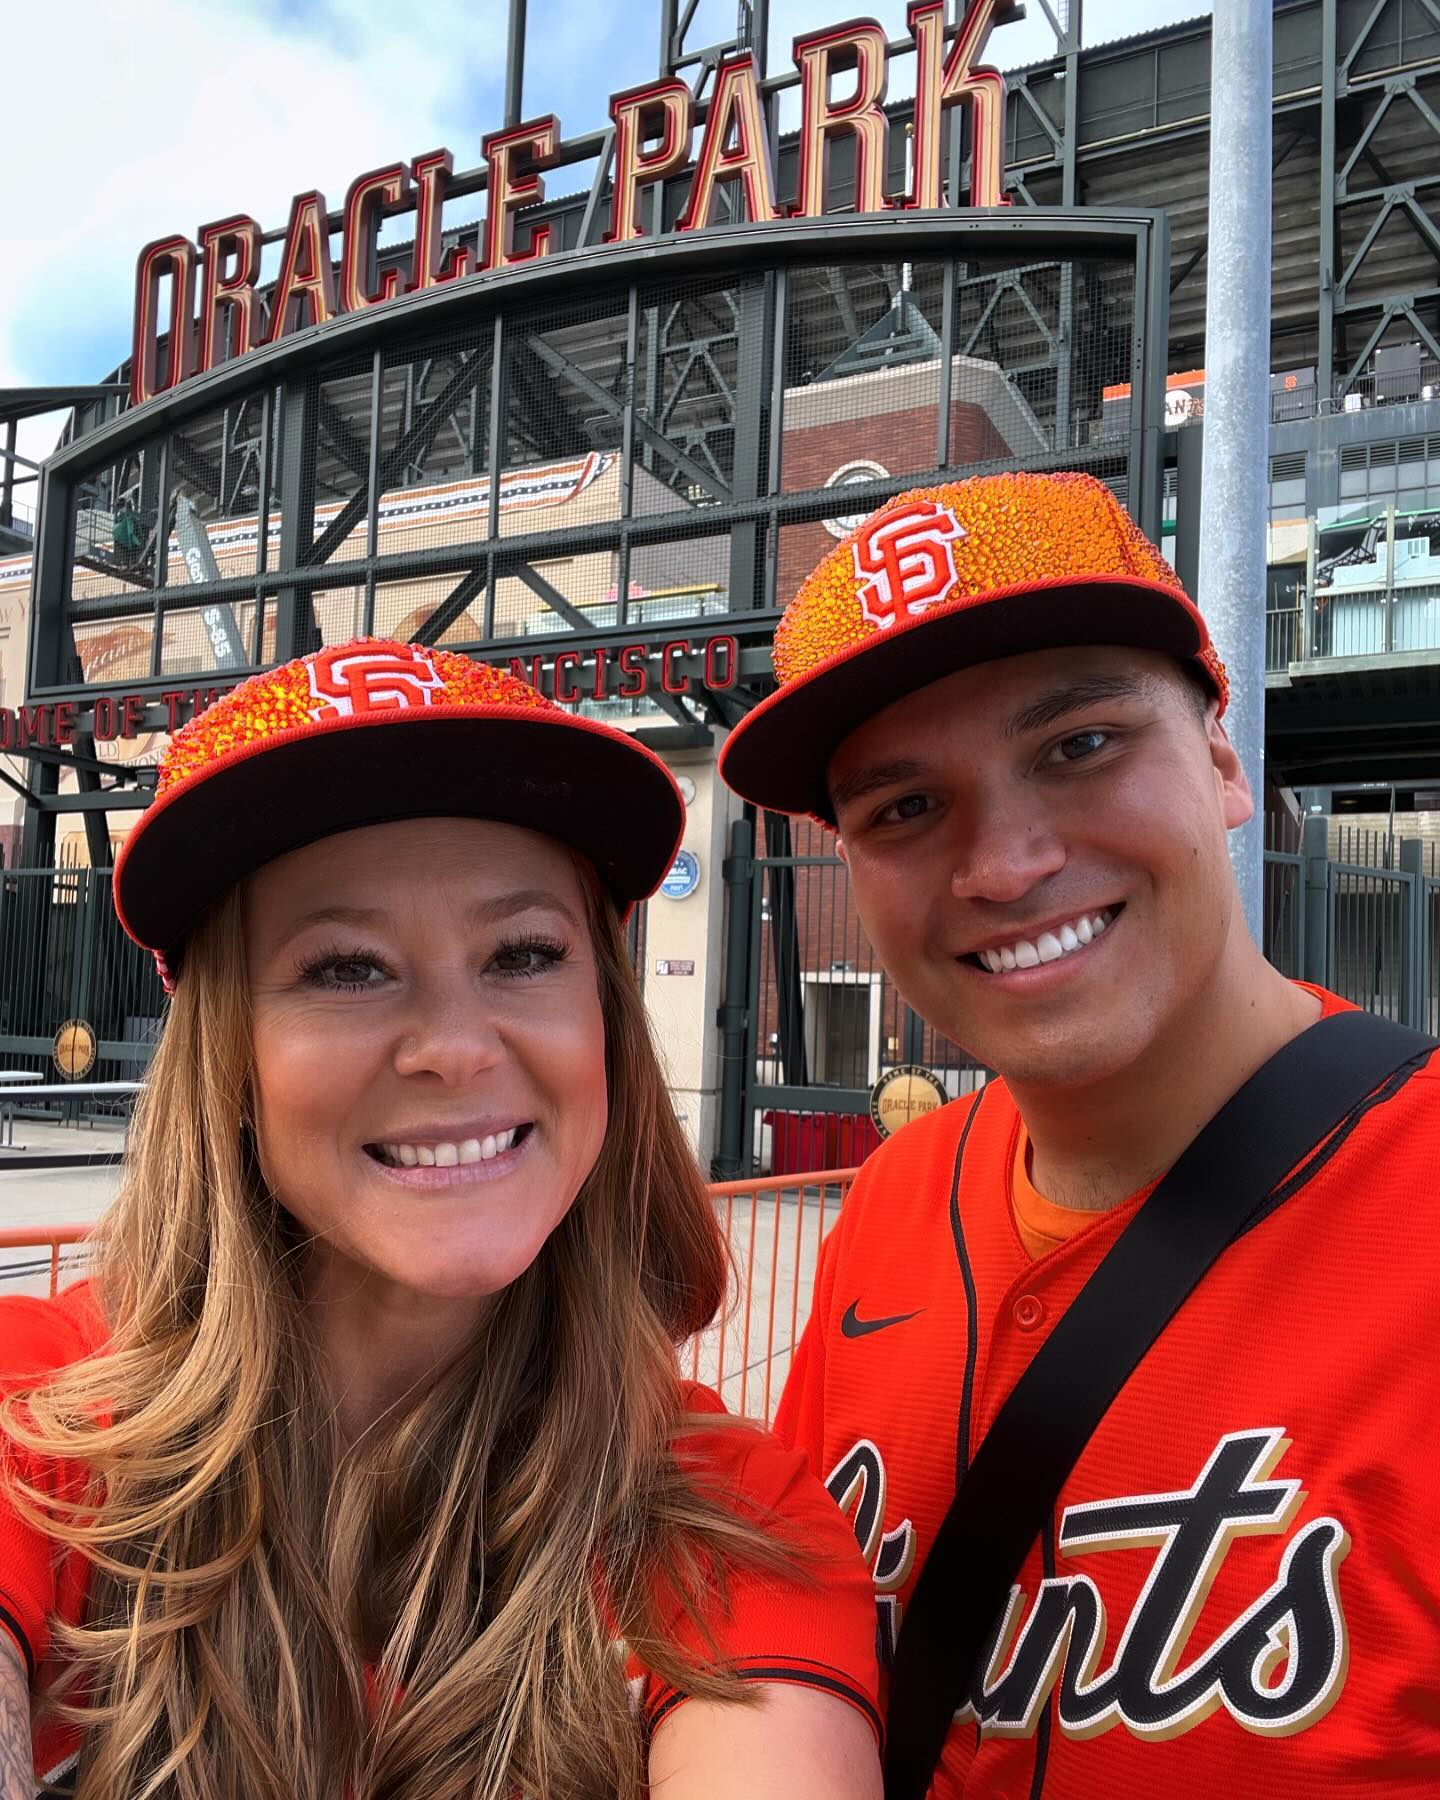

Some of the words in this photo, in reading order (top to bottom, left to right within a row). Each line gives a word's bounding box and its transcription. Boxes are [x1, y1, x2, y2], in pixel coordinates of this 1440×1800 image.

[130, 114, 562, 407] ORACLE
[603, 0, 1012, 243] PARK
[852, 500, 967, 630] SF
[0, 703, 76, 748] OME
[93, 695, 142, 741] OF
[509, 634, 738, 703] NCISCO
[305, 638, 445, 721] SF
